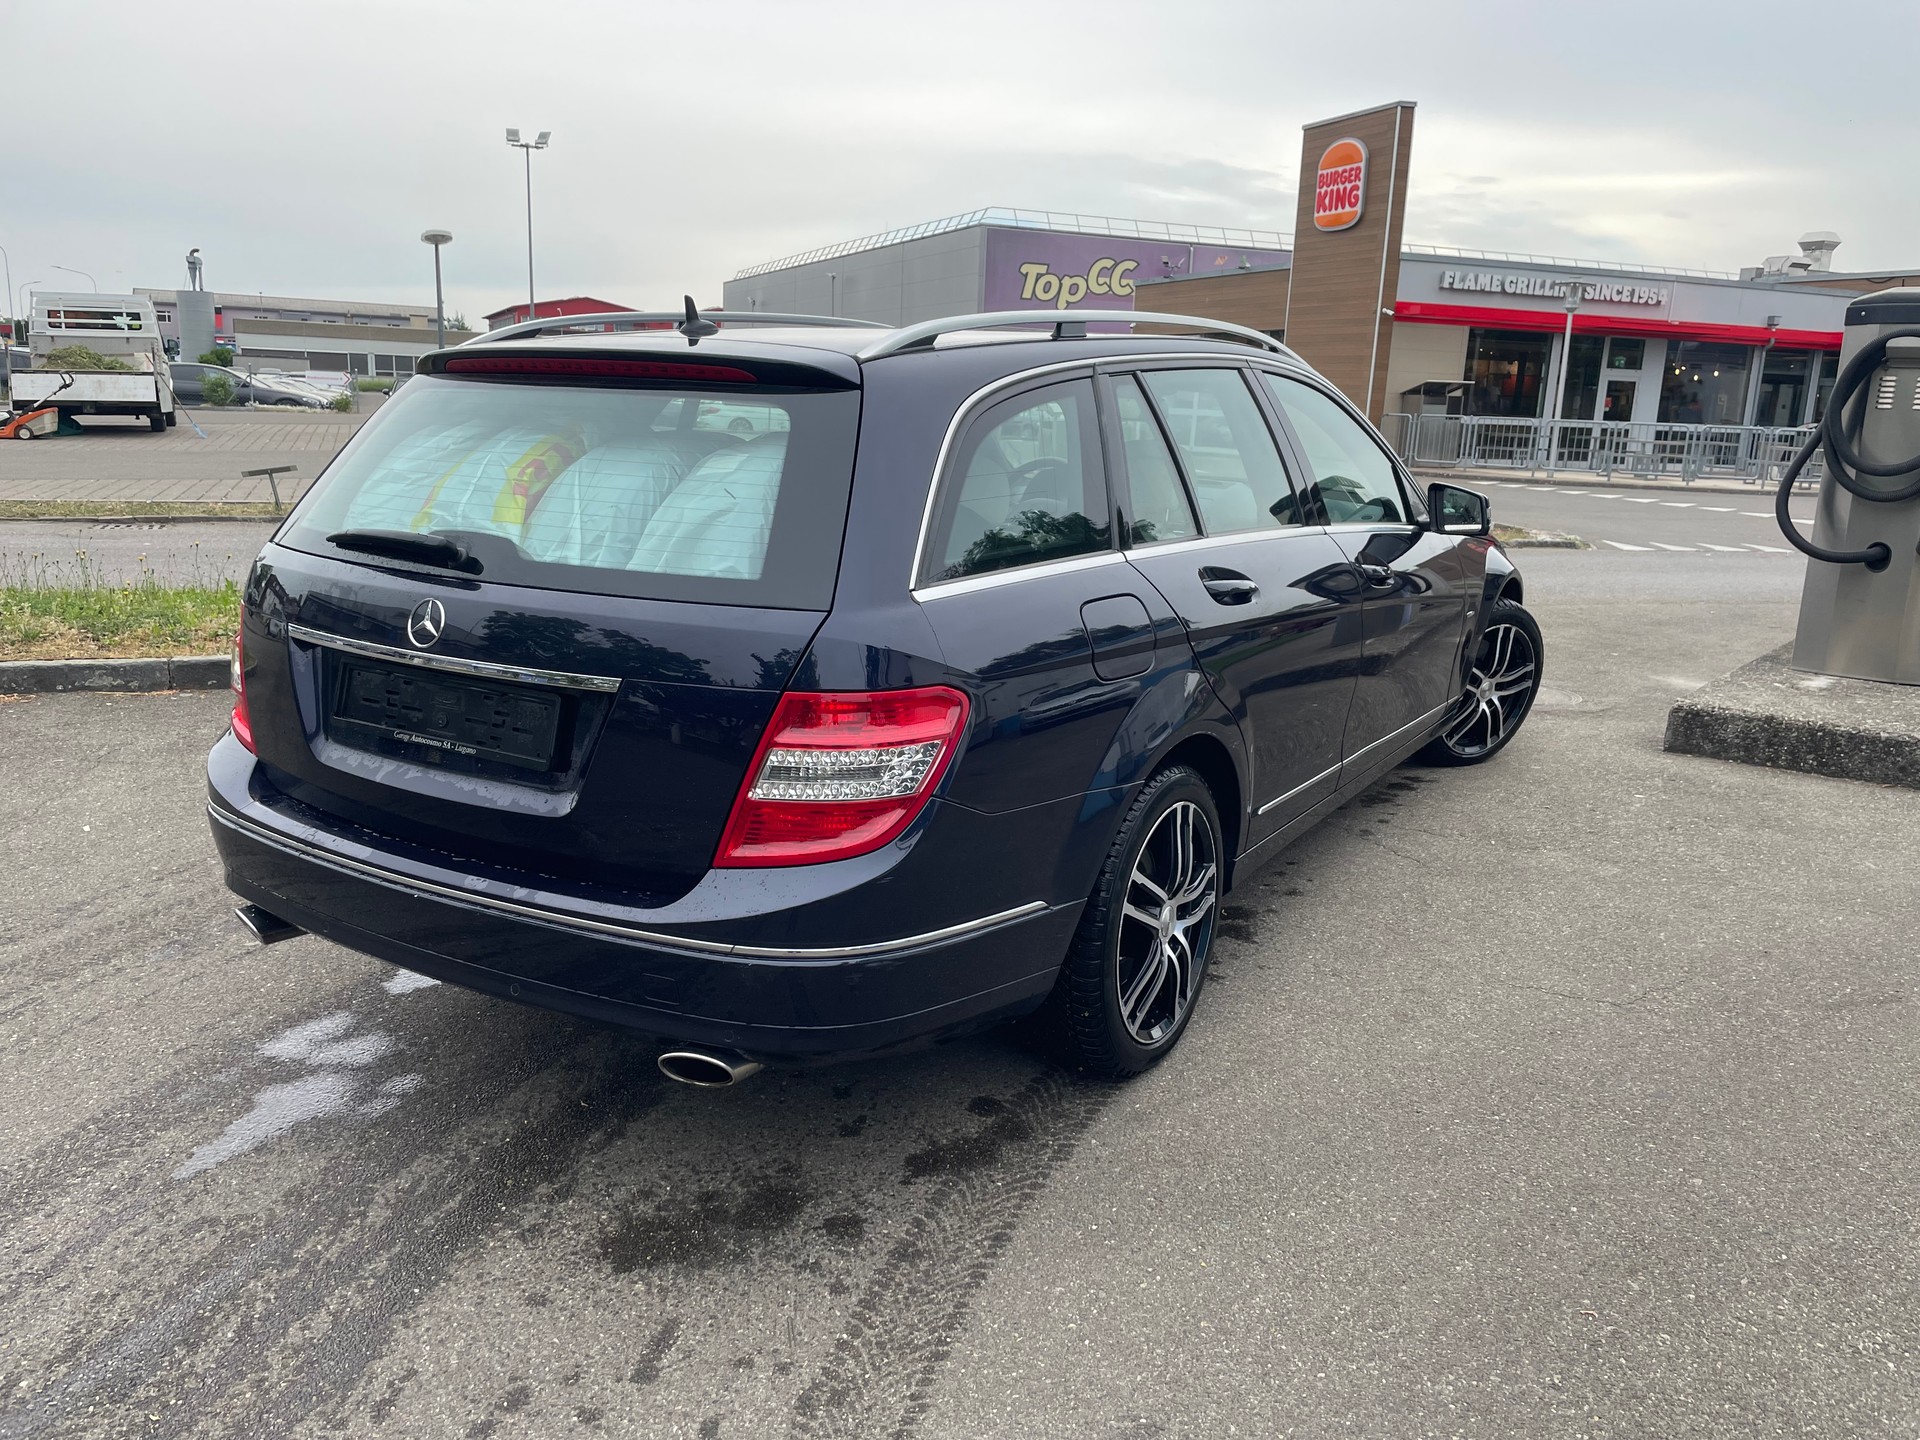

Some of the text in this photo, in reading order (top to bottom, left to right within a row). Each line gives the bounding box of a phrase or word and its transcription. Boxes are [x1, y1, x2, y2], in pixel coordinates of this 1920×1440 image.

[1318, 165, 1362, 189] BURGER
[1316, 184, 1360, 214] KING
[1018, 257, 1139, 310] TopCC
[1442, 271, 1501, 292] FLAME
[1584, 284, 1631, 302] SINCE
[1632, 286, 1668, 305] 1954
[410, 734, 442, 747] Autocosmo
[442, 741, 451, 749] SA
[454, 742, 477, 755] Lugano
